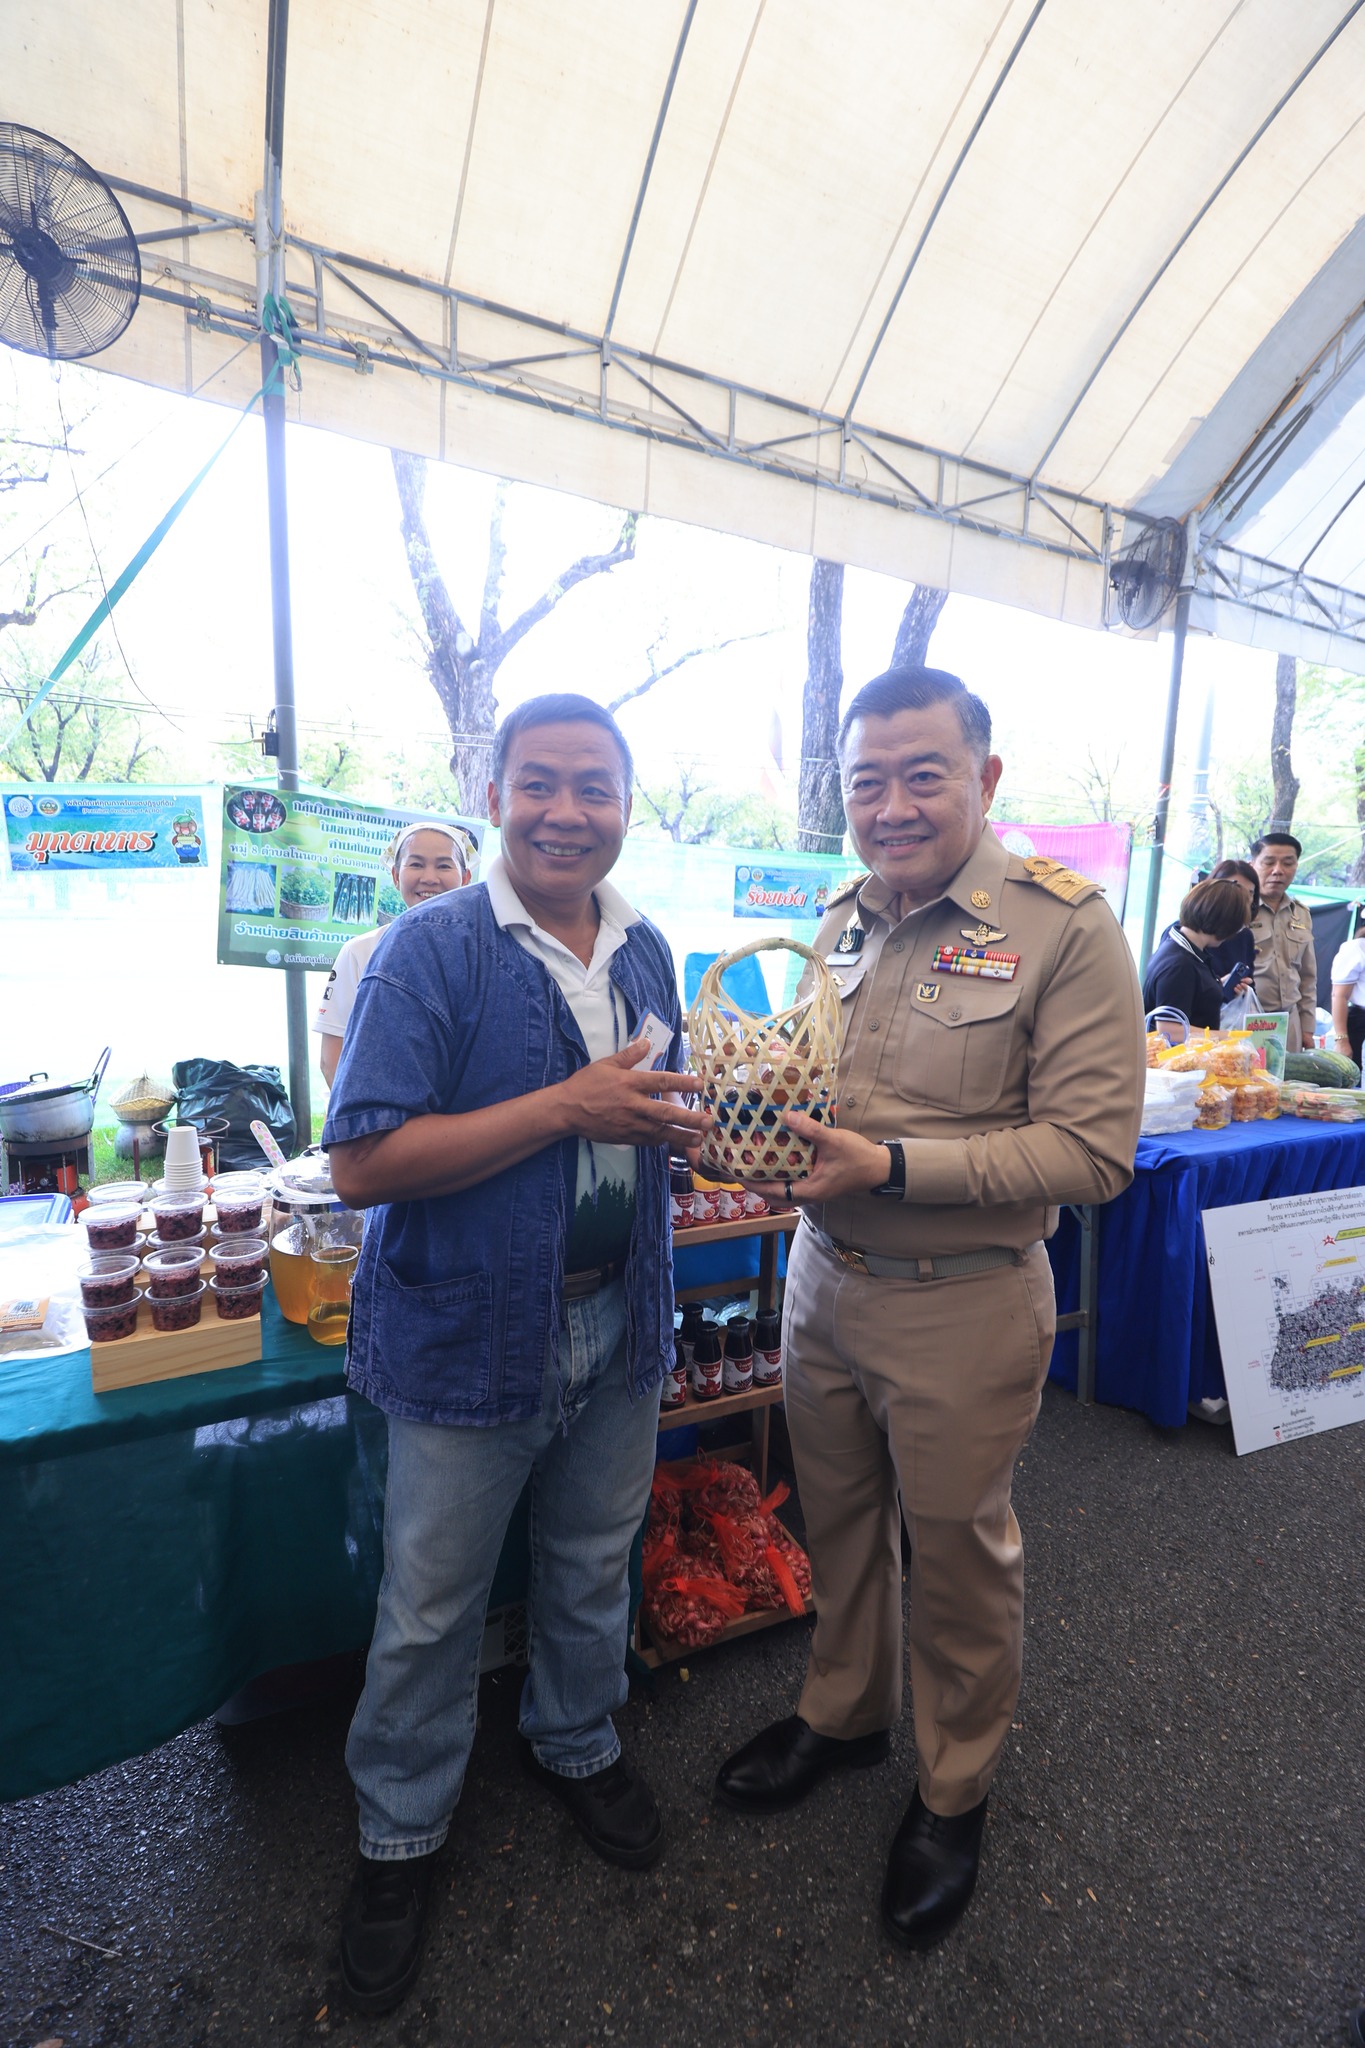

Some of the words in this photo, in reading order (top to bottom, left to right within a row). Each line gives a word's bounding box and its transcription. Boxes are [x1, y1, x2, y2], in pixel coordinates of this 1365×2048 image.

[292, 800, 414, 828] กลุ่มวิสาหกิจชุมชนวนเก
[320, 820, 395, 843] ในเขตปฏิรูปที่ดิ
[26, 831, 156, 864] มุกดาหาร
[229, 843, 248, 857] หมู่
[251, 847, 259, 855] 8
[261, 844, 329, 864] ตำบลโนนยาง
[746, 884, 808, 907] ร้อยเอ็ด
[234, 921, 355, 943] จำหน่ายสินค้าเกษ
